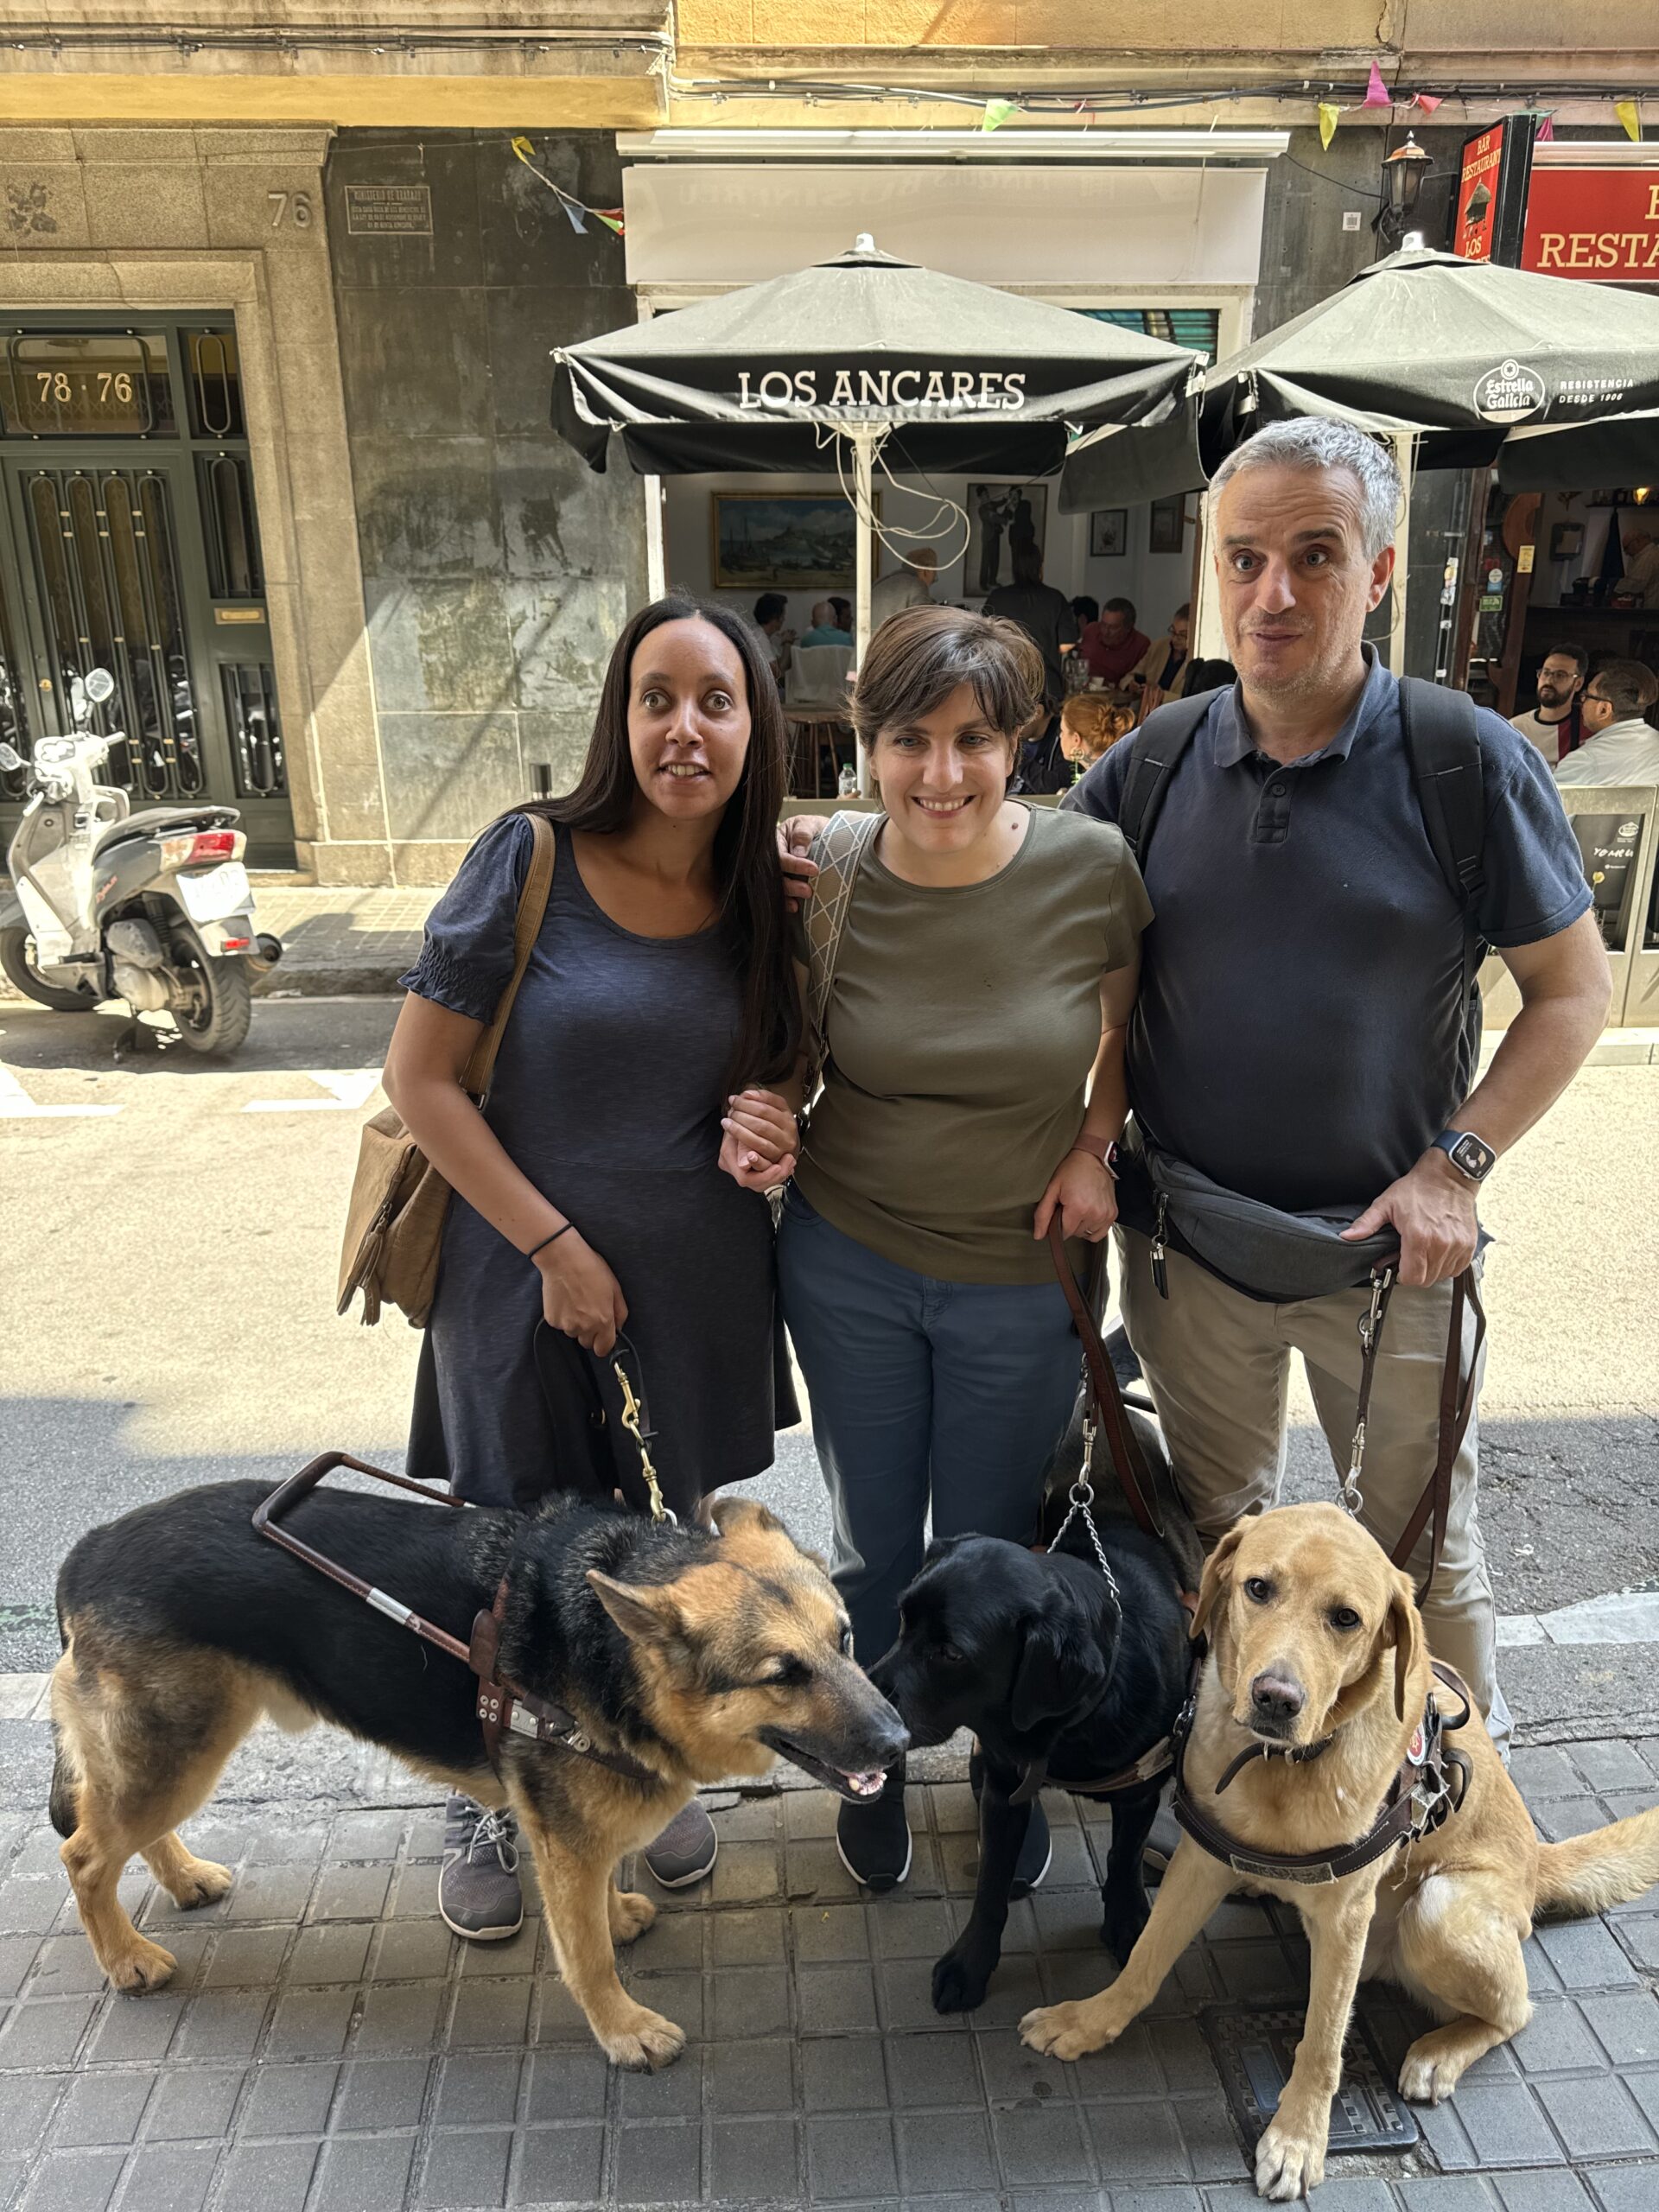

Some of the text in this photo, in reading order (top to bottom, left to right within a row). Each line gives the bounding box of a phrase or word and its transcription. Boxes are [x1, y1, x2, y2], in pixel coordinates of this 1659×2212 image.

[1477, 135, 1491, 156] BAR
[1461, 148, 1502, 183] RESTAURANT
[267, 190, 313, 229] 76
[1465, 235, 1483, 259] LOS
[36, 372, 132, 403] 78 76
[738, 369, 1026, 410] LOS ANCARES
[1484, 378, 1535, 395] Estrella
[1560, 378, 1634, 391] RESISTENCIA
[1486, 391, 1531, 410] Galicia
[1559, 392, 1624, 404] DESDE 1906
